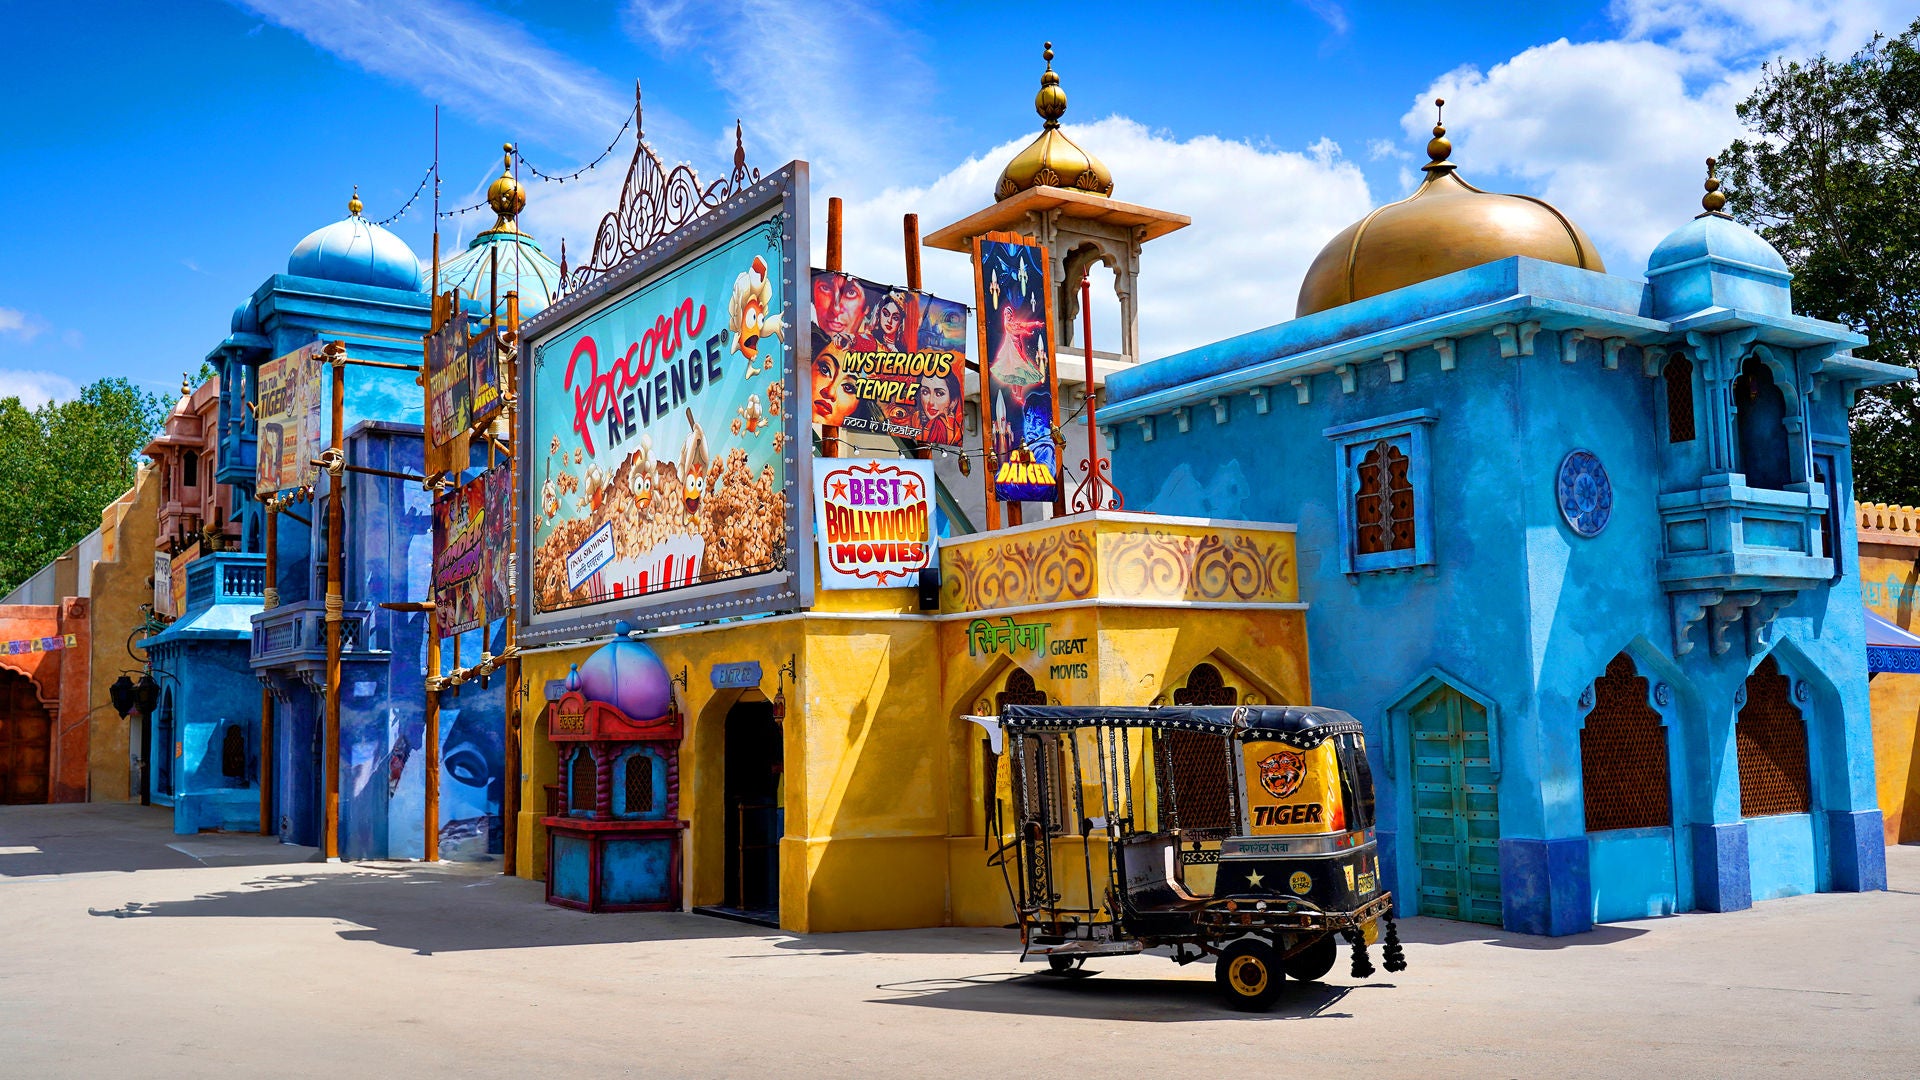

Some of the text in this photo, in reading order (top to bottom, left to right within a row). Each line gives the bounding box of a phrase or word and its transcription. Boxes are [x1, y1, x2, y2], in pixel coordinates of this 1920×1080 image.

[564, 297, 707, 456] Popcorn
[842, 351, 954, 378] MYSTERIOUS
[261, 387, 287, 419] TIGER
[856, 379, 921, 406] TEMPLE
[843, 416, 922, 437] now in theater
[849, 478, 902, 506] BEST
[824, 499, 929, 544] BOLLYWOOD
[438, 509, 485, 571] WONDER
[570, 531, 609, 570] FINAL SHOWINGS
[836, 543, 925, 564] MOVIES
[965, 616, 1052, 658] सिनेमा
[1050, 638, 1088, 656] GREAT
[1050, 663, 1088, 680] MOVIES
[1253, 802, 1324, 827] TIGER
